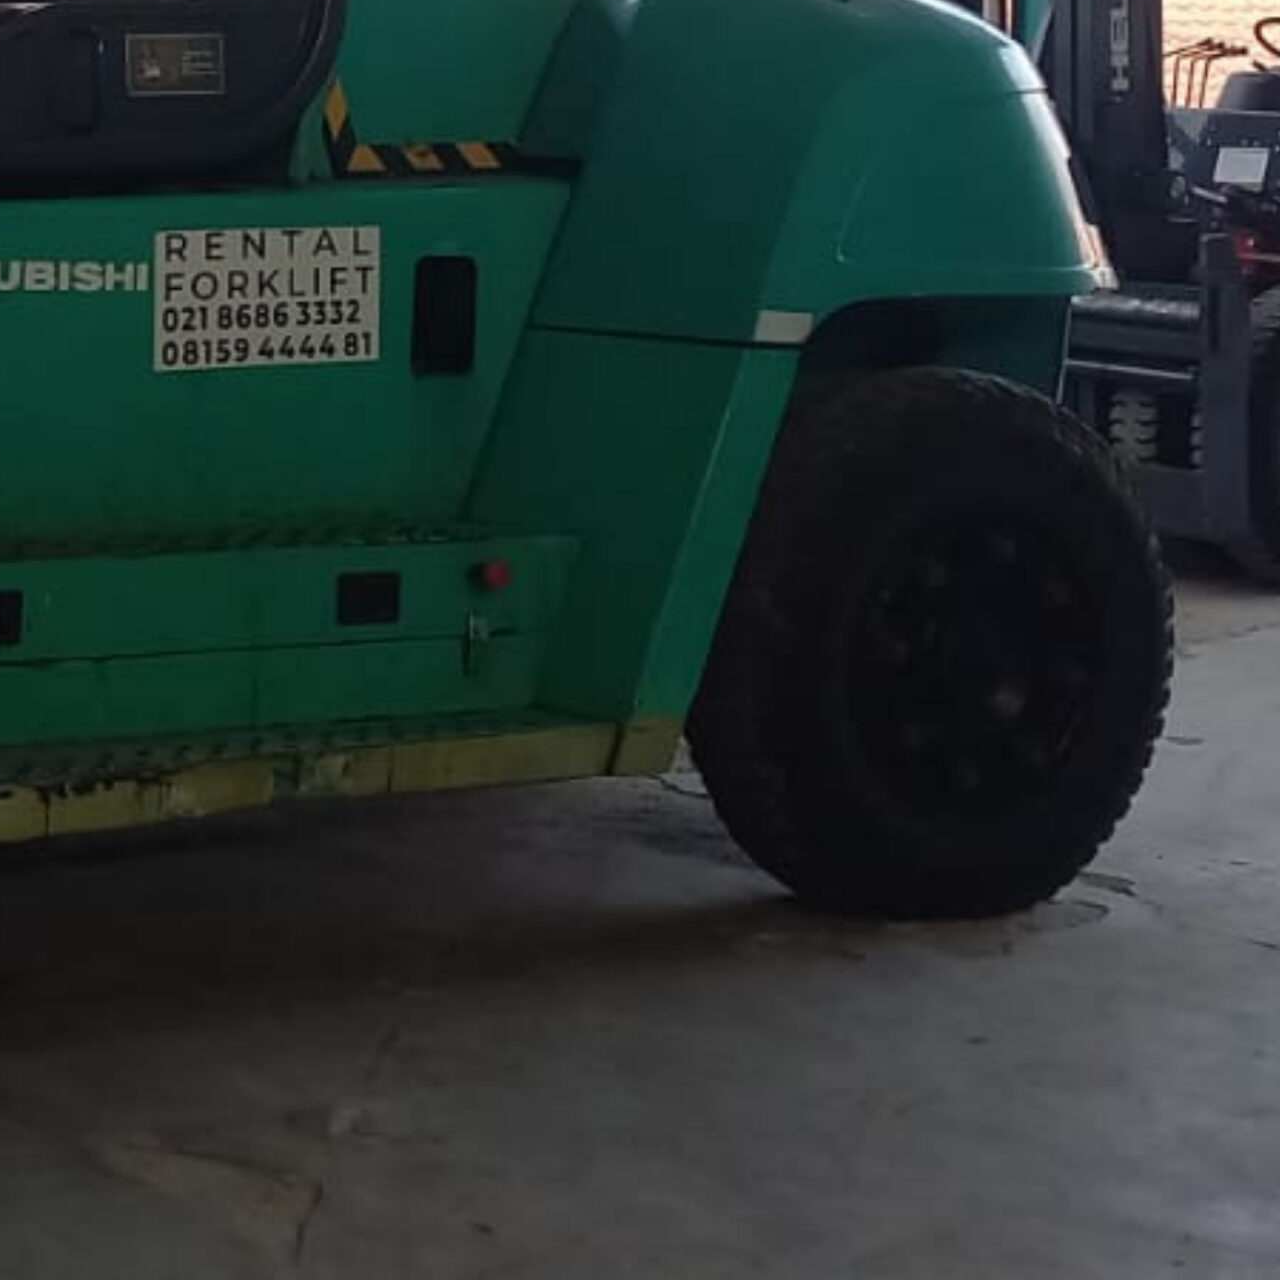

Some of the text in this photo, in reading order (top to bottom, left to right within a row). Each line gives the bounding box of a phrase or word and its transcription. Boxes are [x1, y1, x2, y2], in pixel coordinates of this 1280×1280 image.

[164, 229, 372, 262] RENTAL
[164, 266, 374, 302] FORKLIFT
[162, 306, 208, 333] 021
[295, 298, 361, 326] 3332
[162, 332, 372, 366] 08159 4444 81
